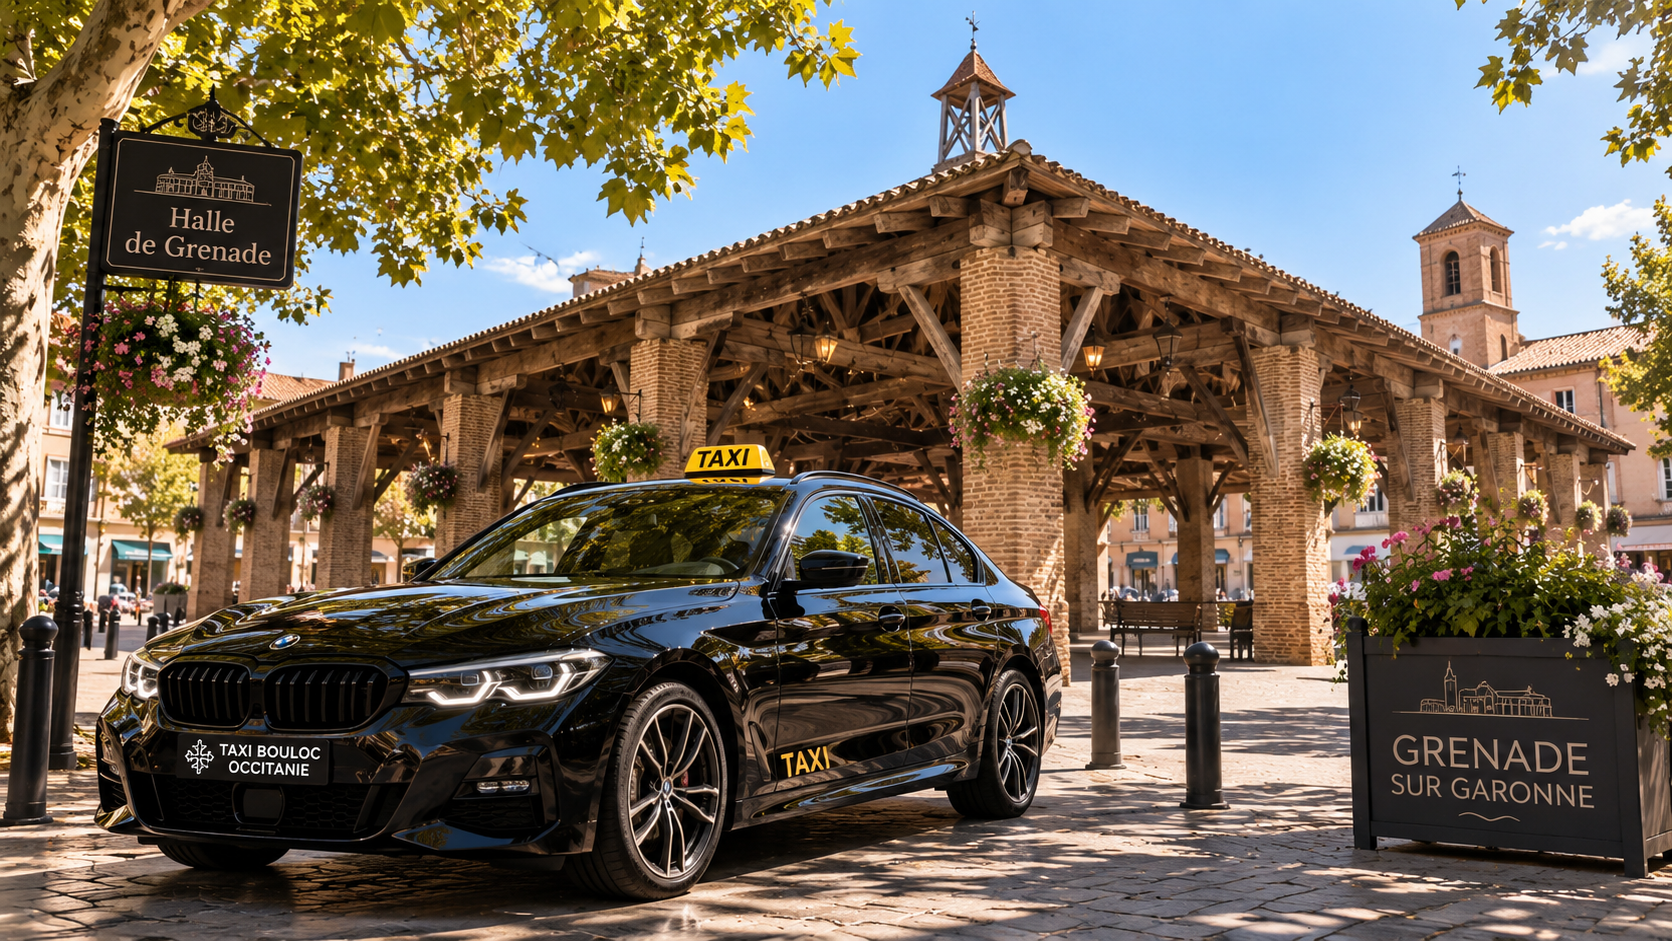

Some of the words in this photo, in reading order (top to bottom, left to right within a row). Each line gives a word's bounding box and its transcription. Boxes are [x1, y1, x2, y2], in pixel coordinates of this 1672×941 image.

[169, 207, 235, 234] Halle
[125, 231, 156, 255] de
[164, 235, 272, 265] Grenade
[697, 448, 750, 468] TAXI
[219, 743, 252, 757] TAXI
[257, 745, 321, 760] BOULOC
[780, 746, 830, 778] TAXI
[1392, 734, 1590, 776] GRENADE
[228, 760, 310, 777] OCCITANIE
[1391, 773, 1442, 798] SUR
[1451, 777, 1595, 809] GARONNE
